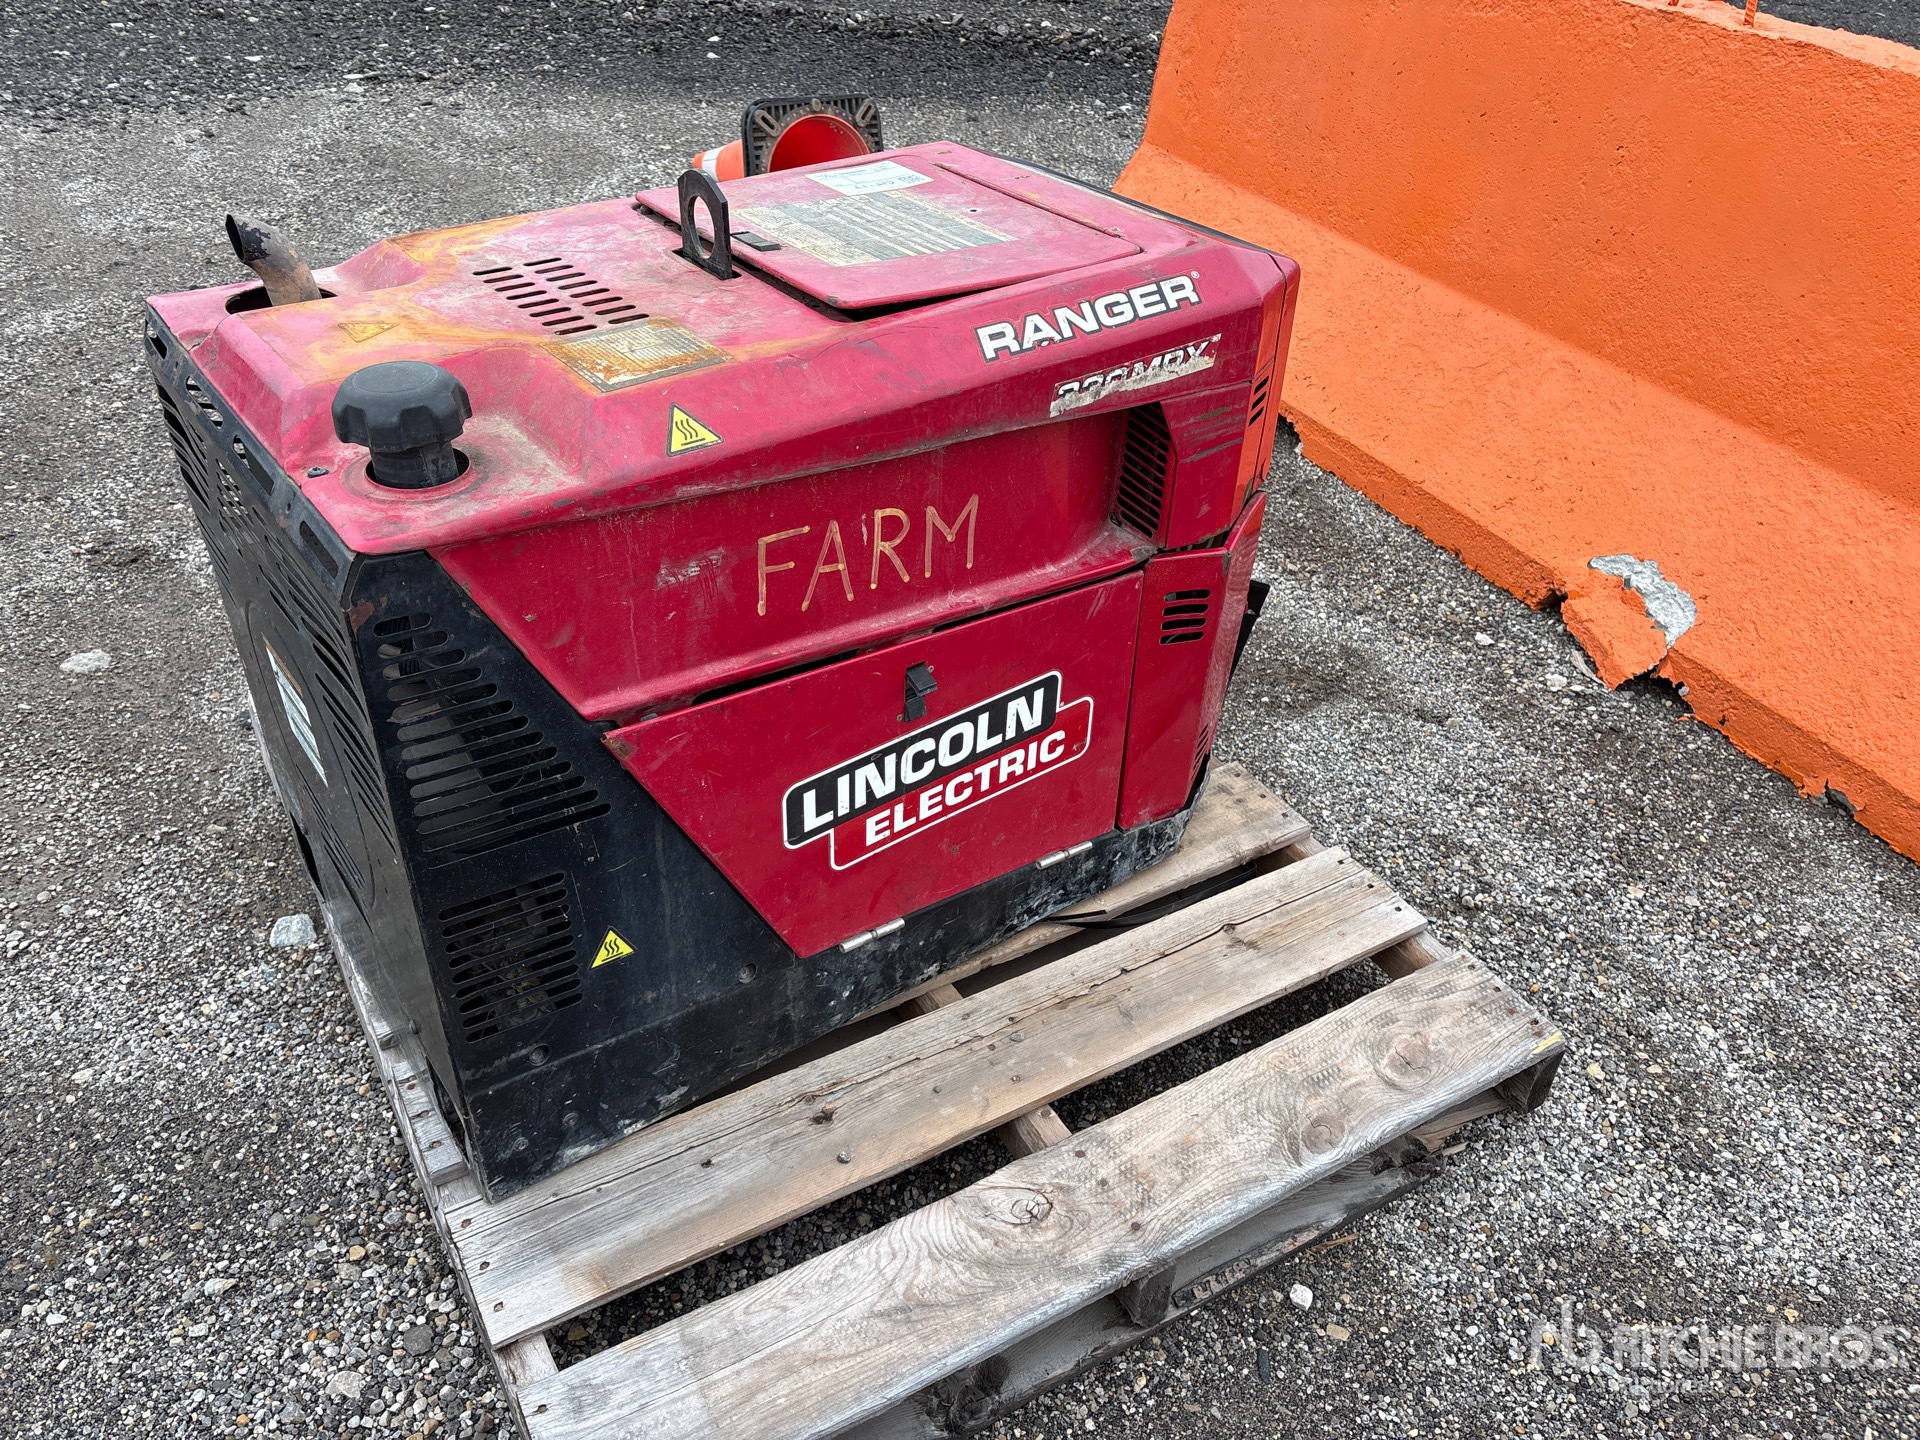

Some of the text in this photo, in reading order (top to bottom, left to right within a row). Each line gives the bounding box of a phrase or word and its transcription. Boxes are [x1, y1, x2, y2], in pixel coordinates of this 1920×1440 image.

[757, 493, 979, 616] FARM
[803, 687, 1045, 833] LINCOLN
[865, 730, 1066, 847] ELECTRIC
